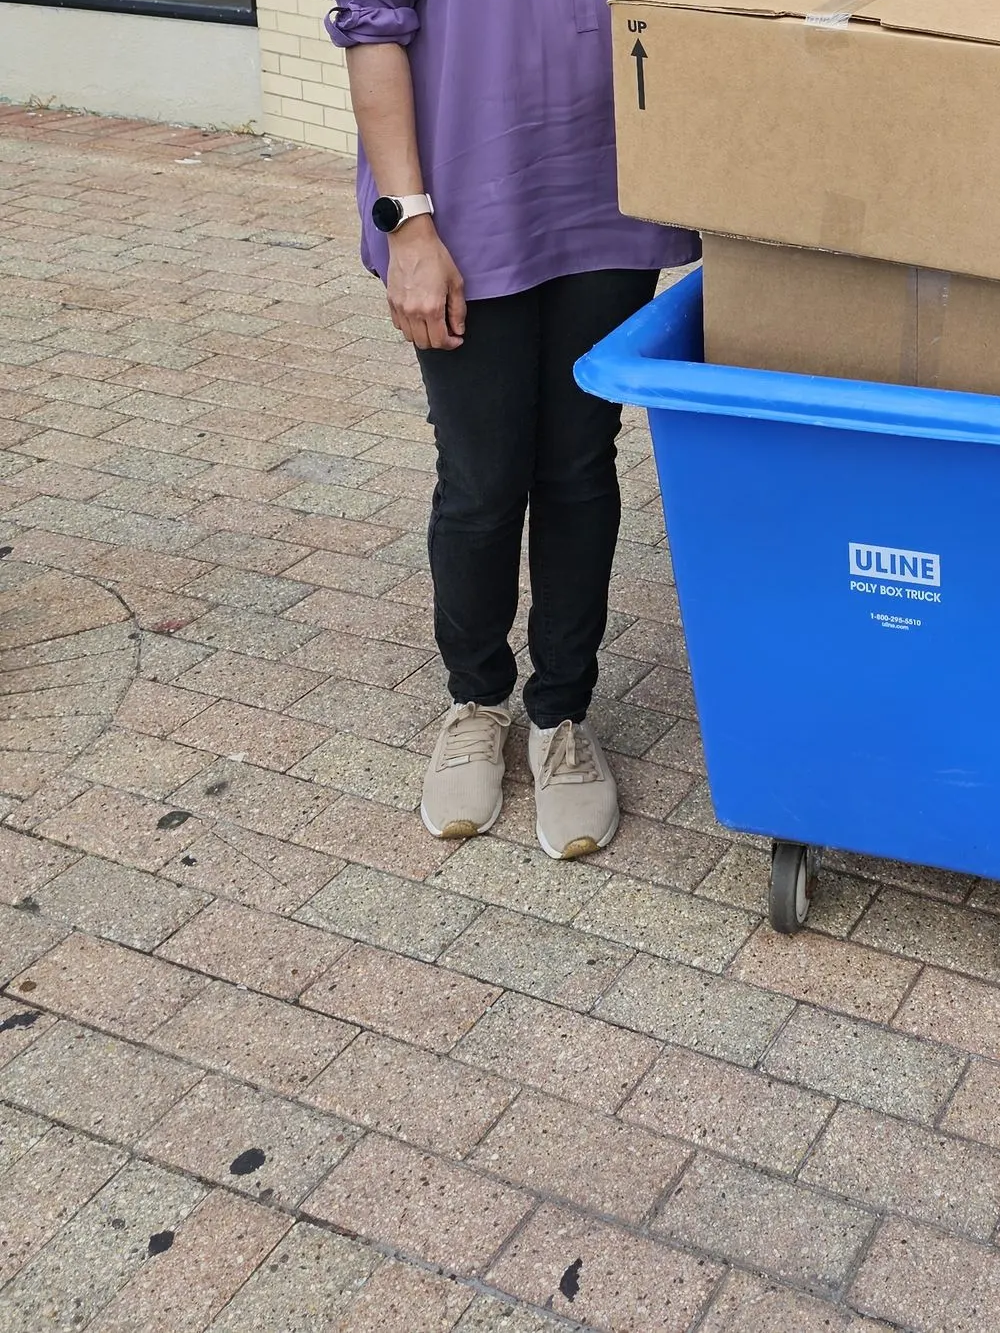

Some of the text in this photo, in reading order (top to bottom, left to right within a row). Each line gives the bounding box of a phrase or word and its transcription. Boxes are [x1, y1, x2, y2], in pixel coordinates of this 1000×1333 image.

[627, 19, 648, 34] UP
[855, 549, 934, 580] ULINE
[850, 580, 941, 602] POLY BOX TRUCK
